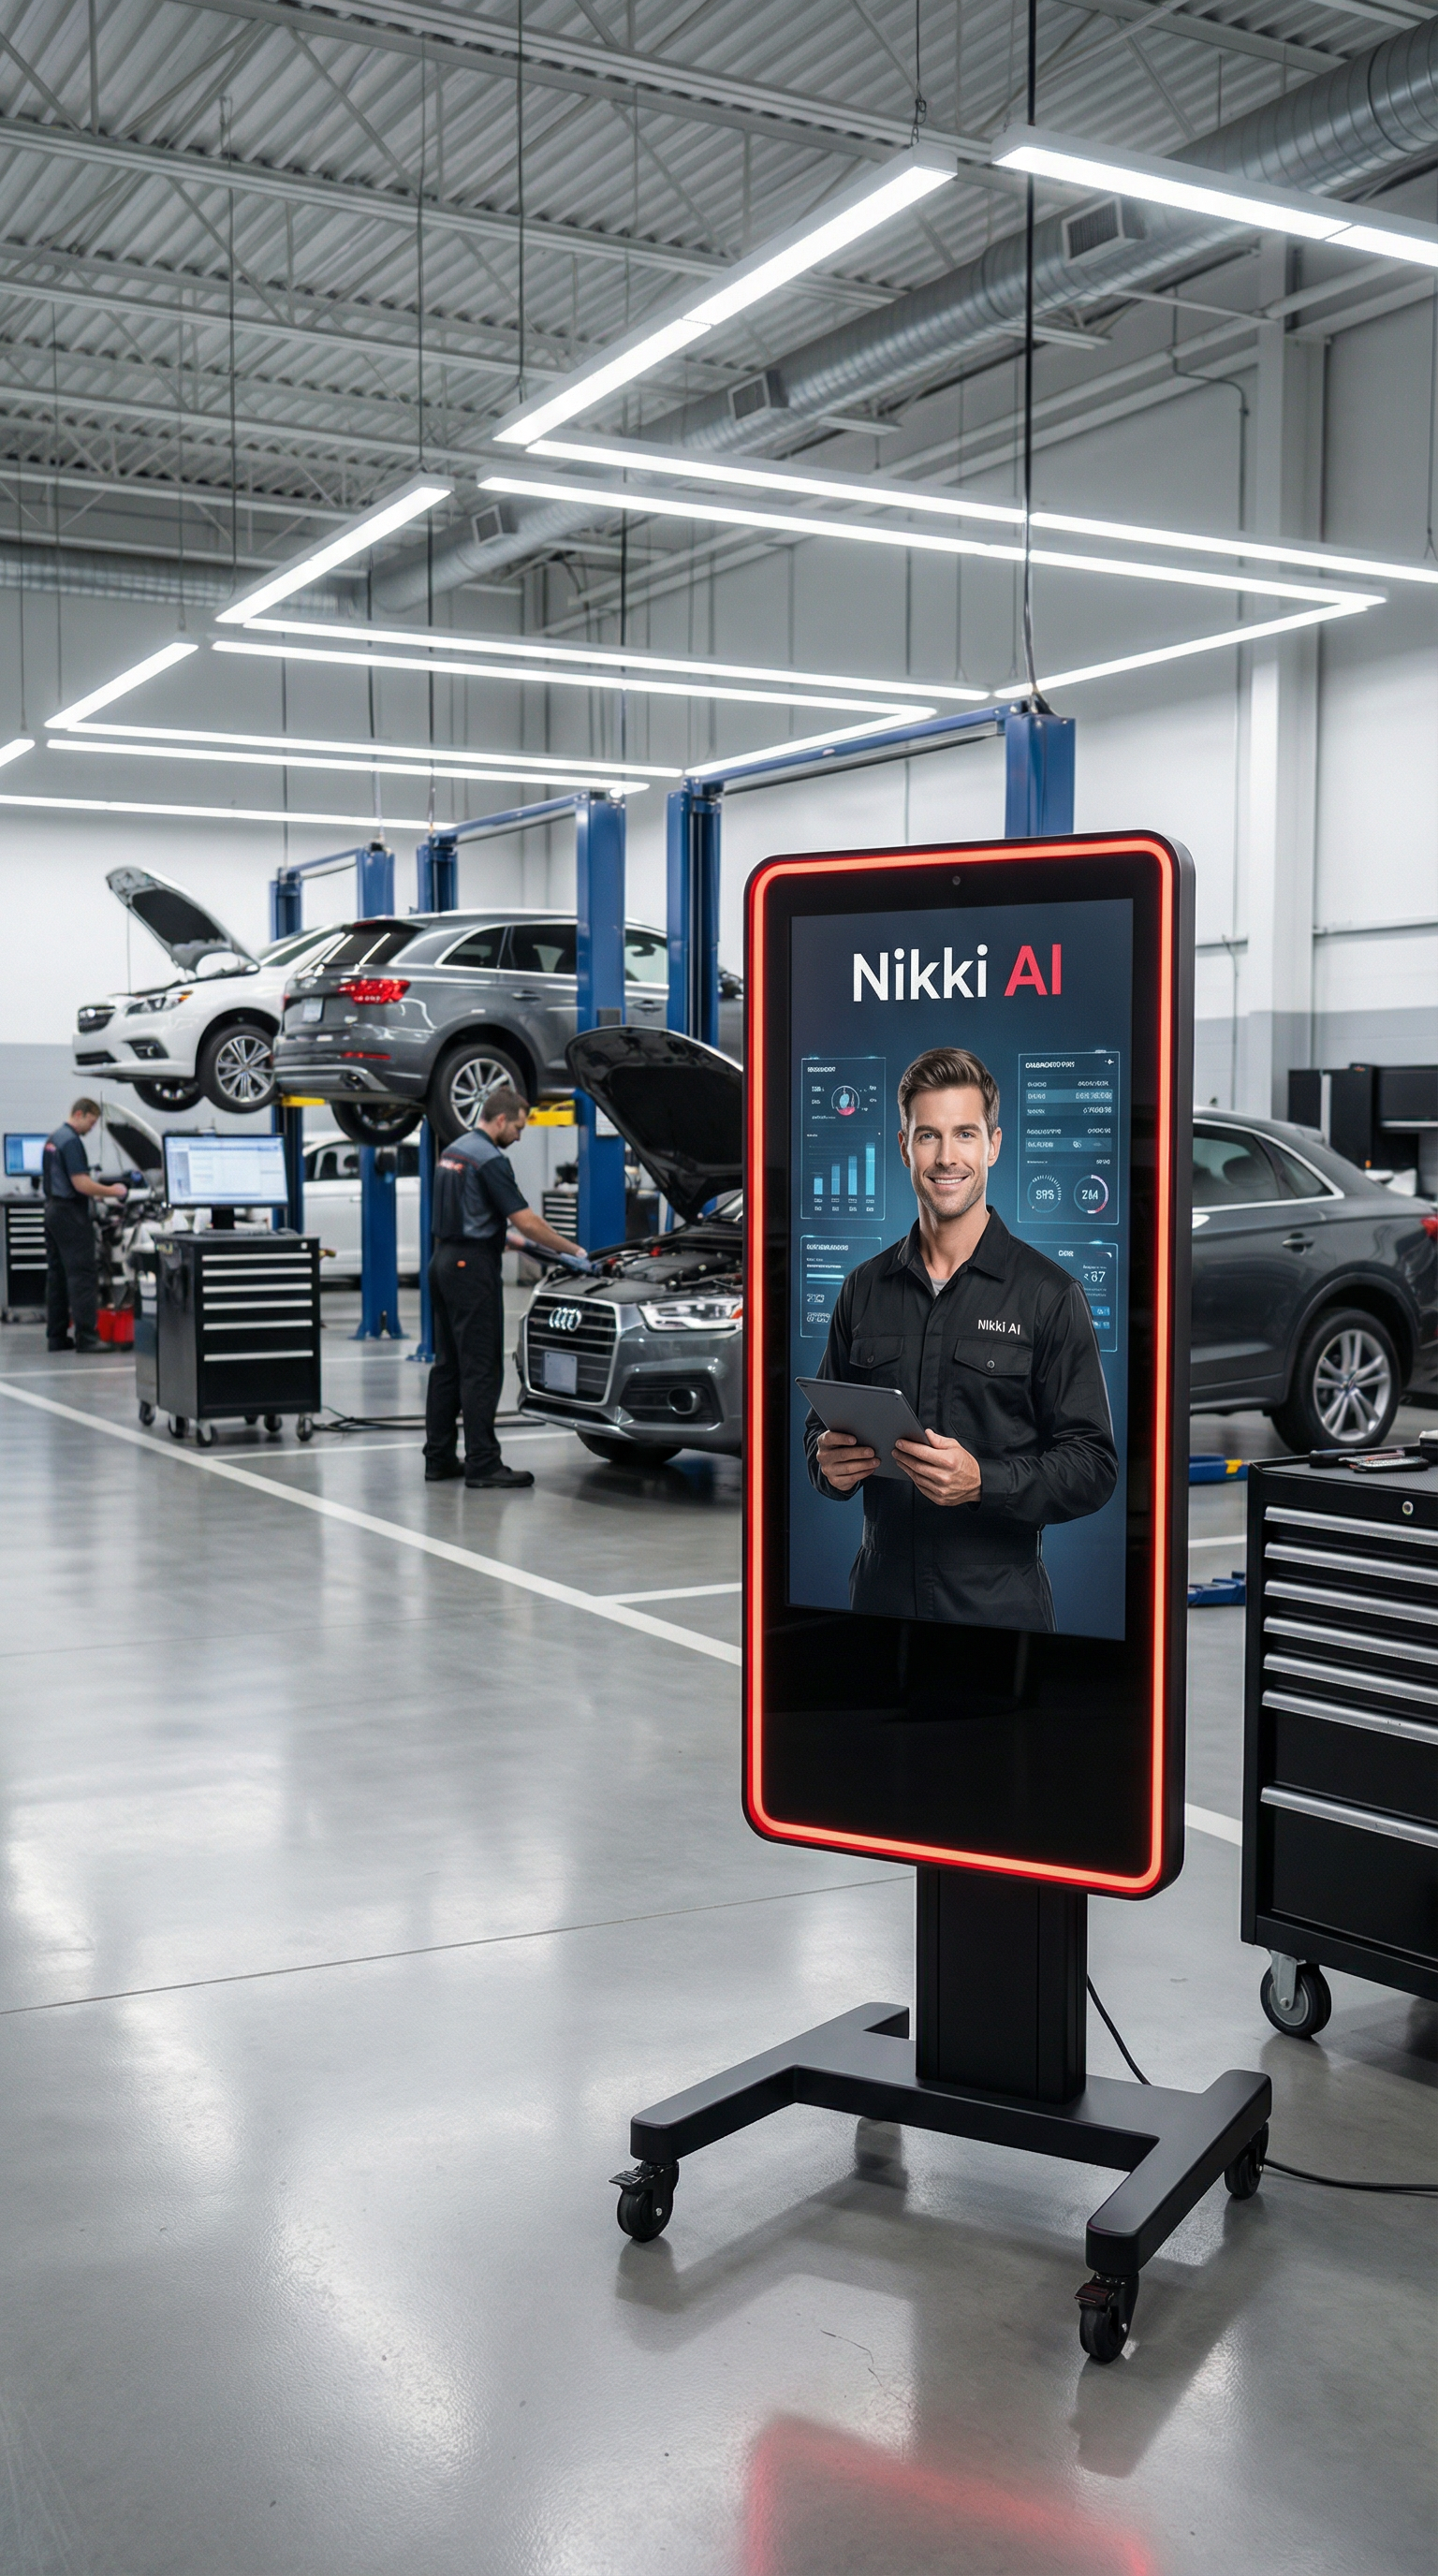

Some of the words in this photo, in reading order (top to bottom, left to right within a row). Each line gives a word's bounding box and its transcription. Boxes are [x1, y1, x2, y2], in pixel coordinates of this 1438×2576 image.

[853, 944, 988, 1002] Nikki
[1004, 944, 1062, 996] AI
[1007, 1323, 1020, 1335] AI
